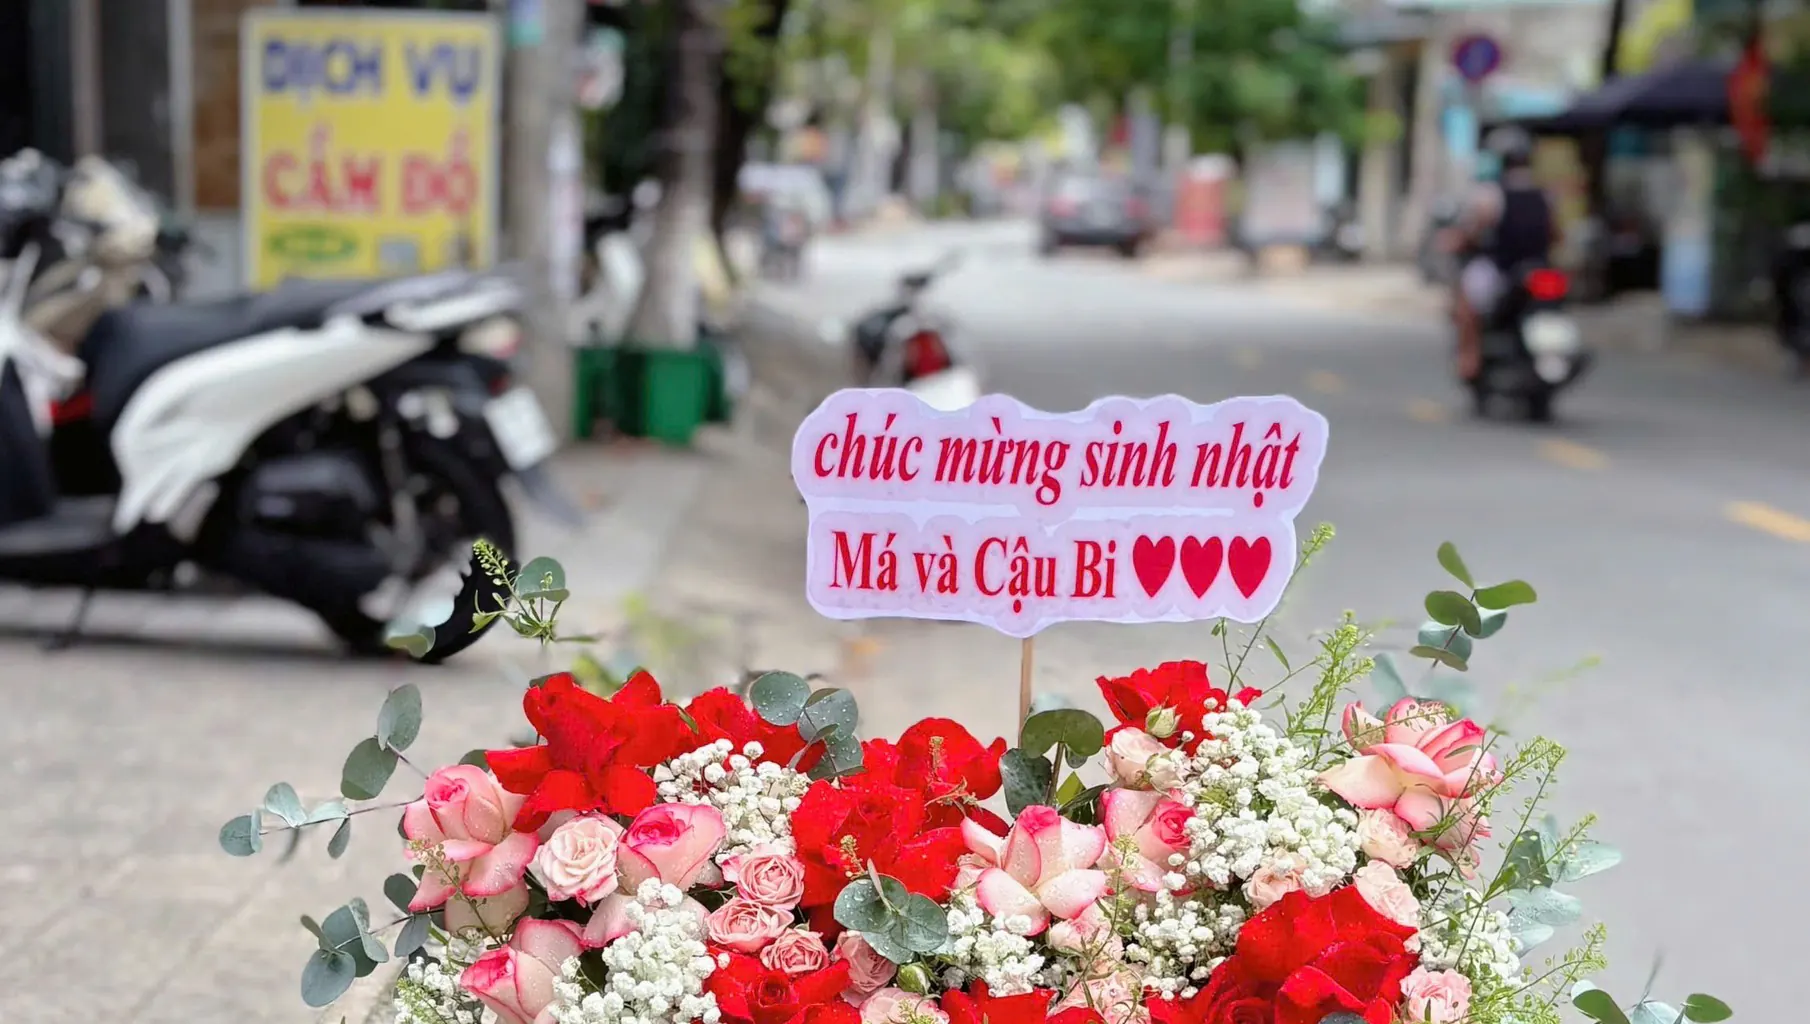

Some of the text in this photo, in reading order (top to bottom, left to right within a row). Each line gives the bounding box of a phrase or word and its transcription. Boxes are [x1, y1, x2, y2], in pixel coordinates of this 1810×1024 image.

[814, 413, 1300, 508] chúc mừng sinh nhật
[829, 530, 1117, 615] Má và Cậu Bi
